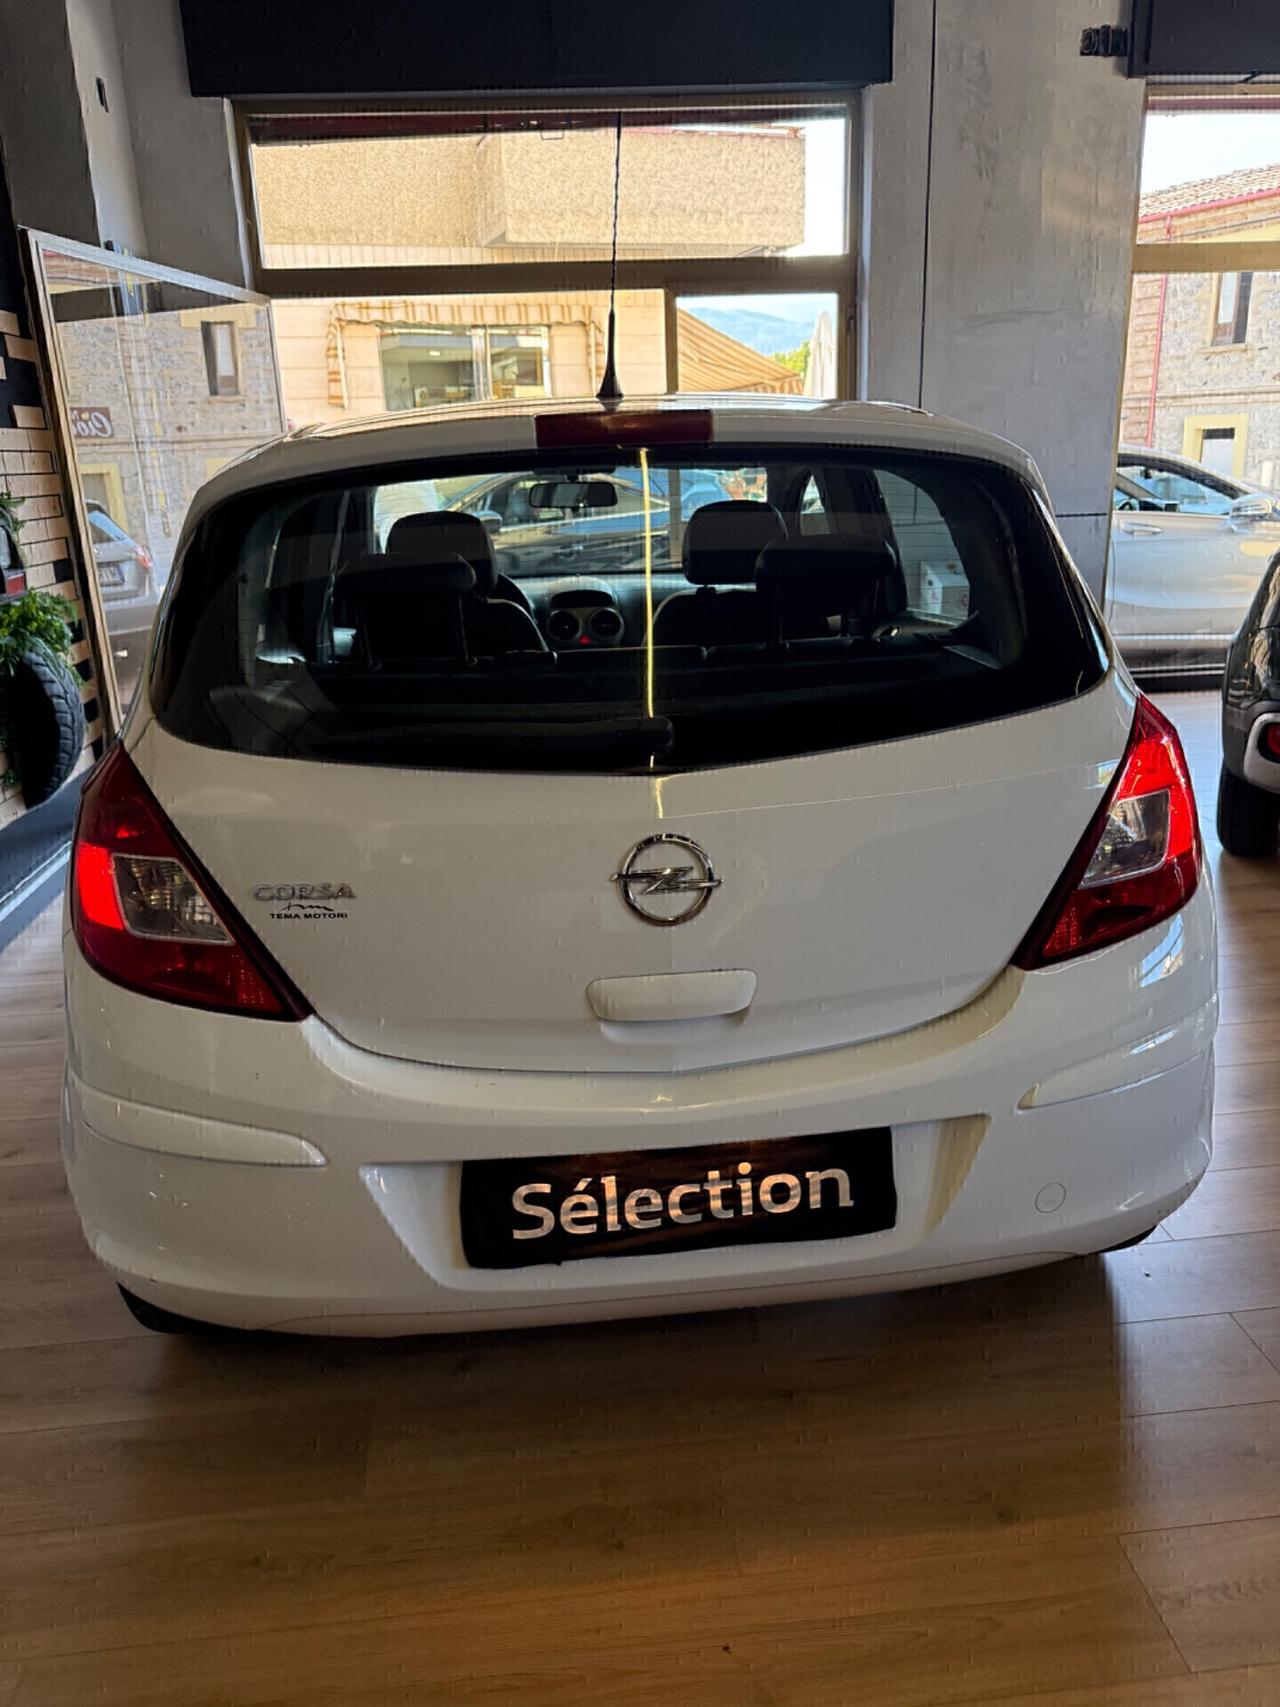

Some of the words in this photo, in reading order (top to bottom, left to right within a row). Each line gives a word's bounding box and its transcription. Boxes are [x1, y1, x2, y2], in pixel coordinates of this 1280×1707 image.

[254, 883, 356, 901] CORSA
[303, 911, 348, 919] MOTORI
[512, 1161, 855, 1240] Sélection
